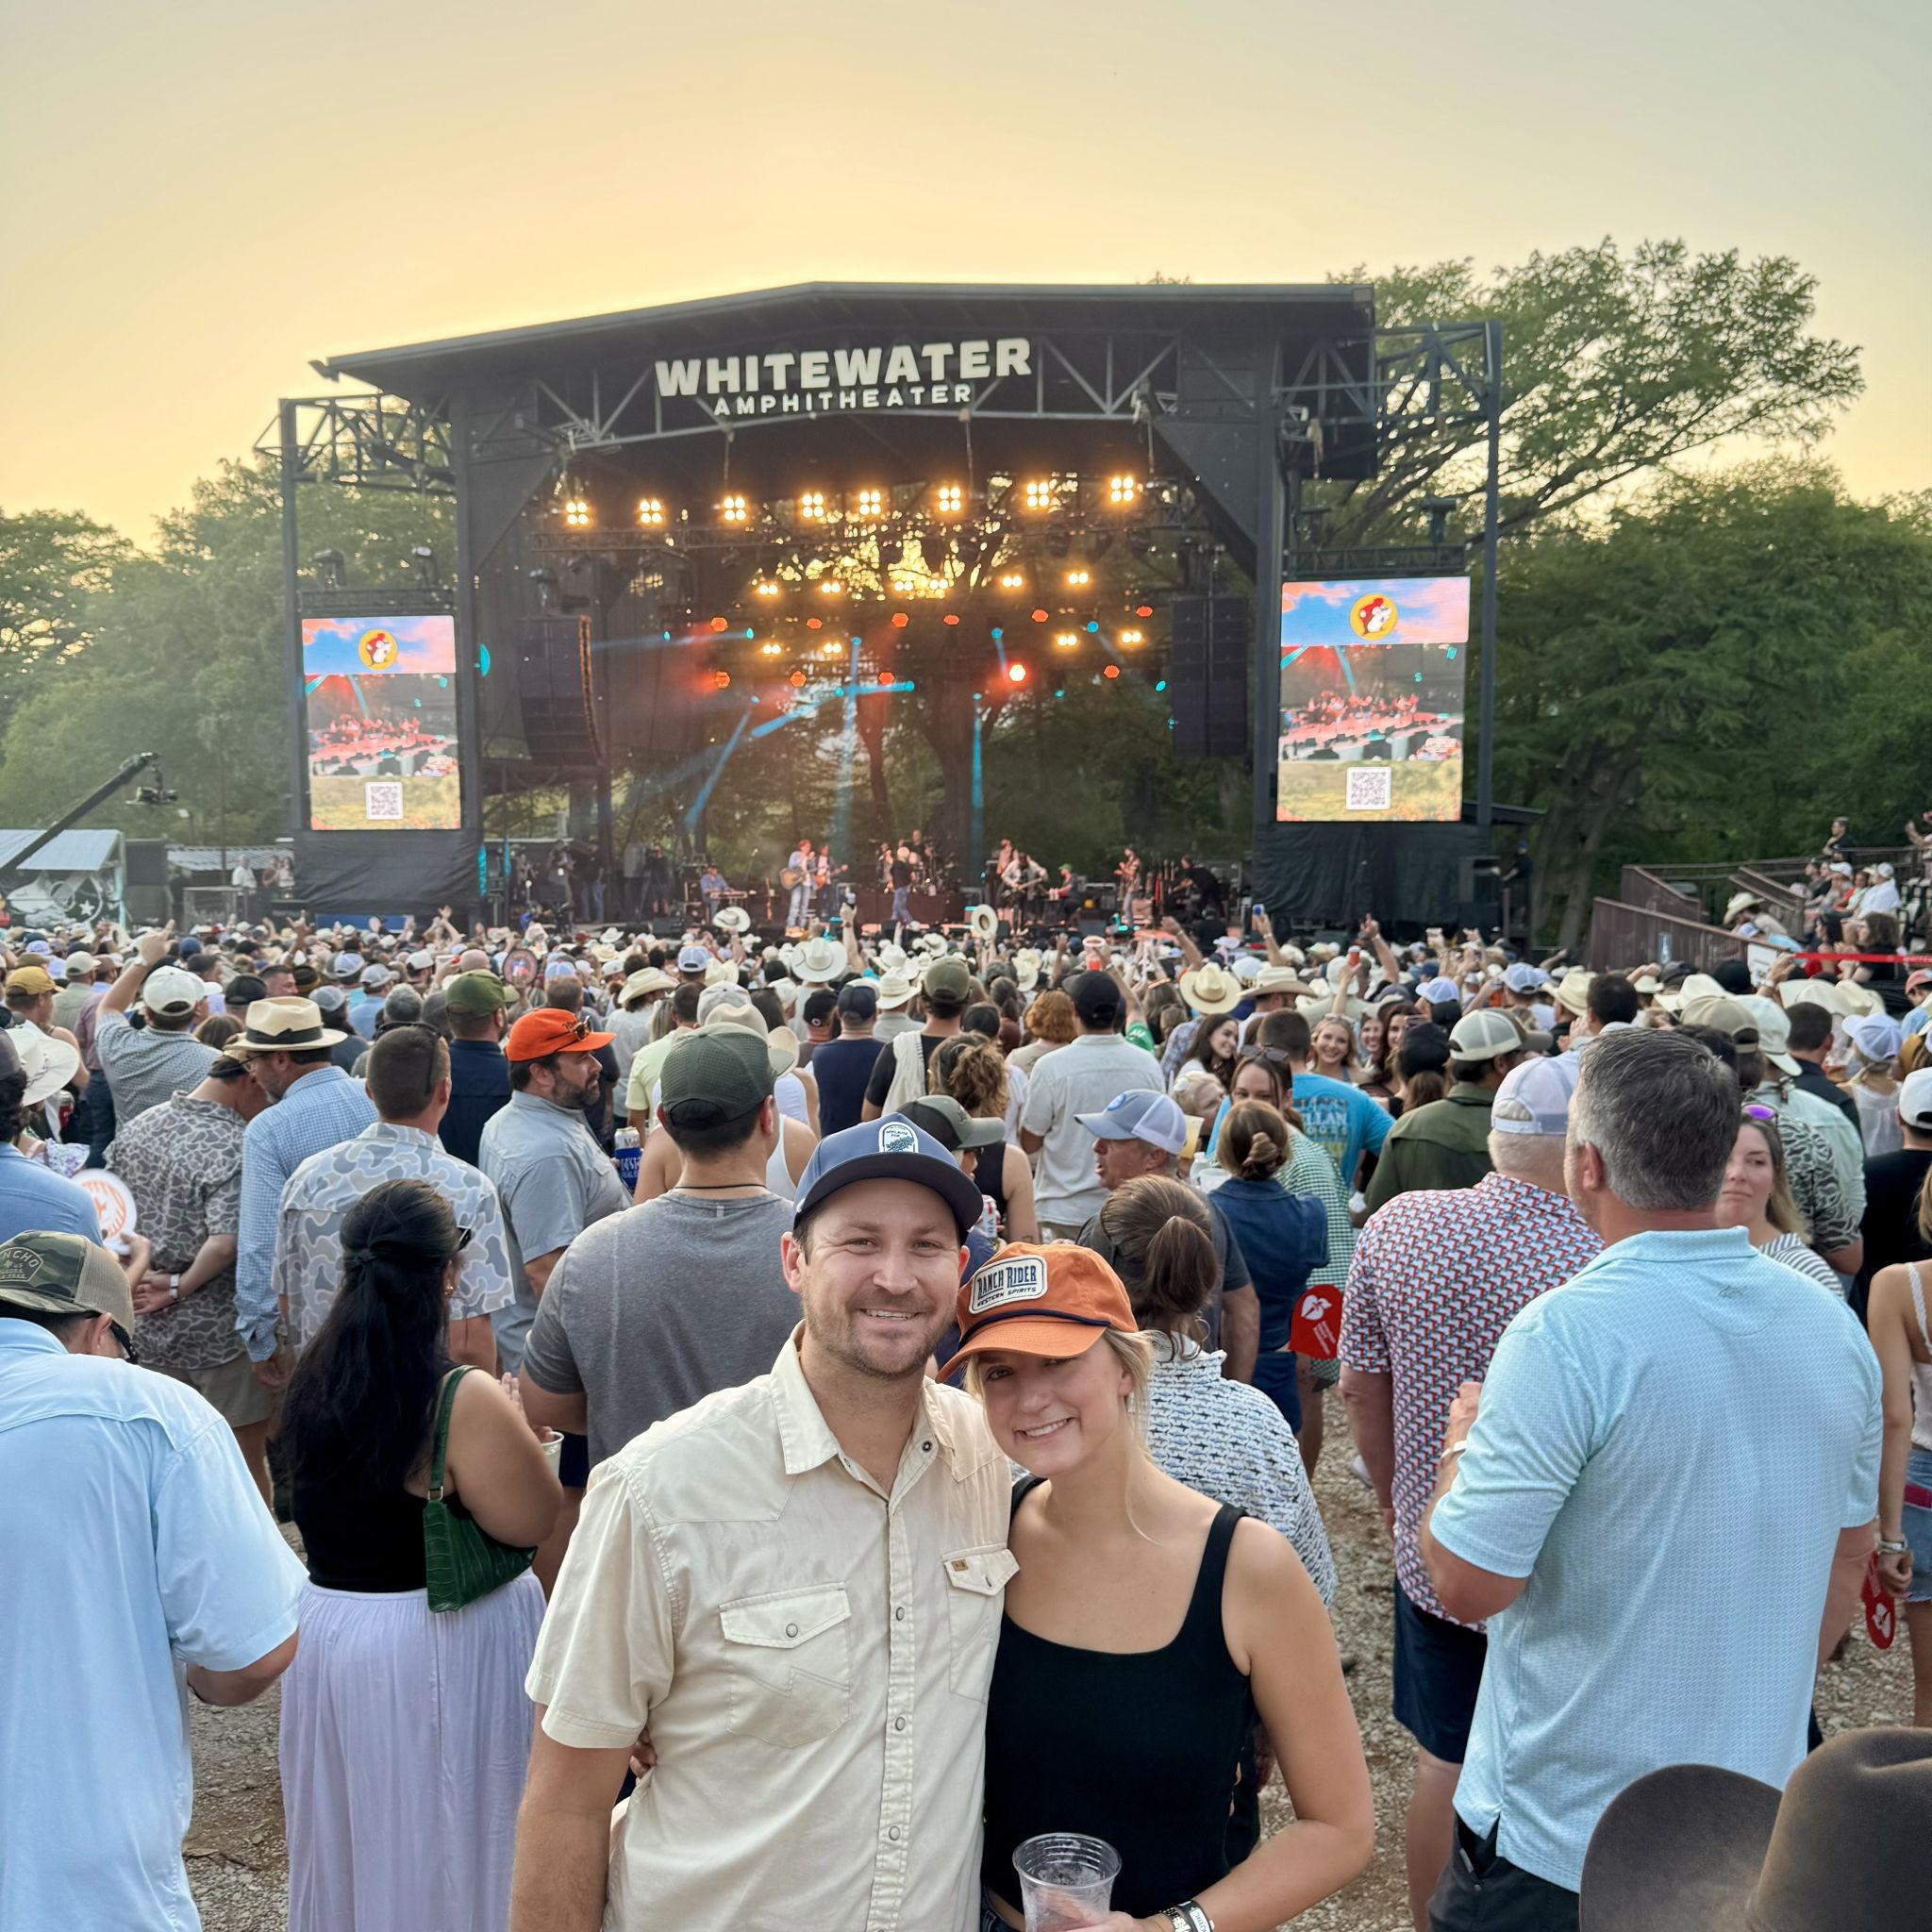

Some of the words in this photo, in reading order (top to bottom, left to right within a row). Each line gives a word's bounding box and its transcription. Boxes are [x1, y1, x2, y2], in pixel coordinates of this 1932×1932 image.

[655, 337, 1032, 397] WHITEWATER
[713, 383, 972, 416] AMPHITHEATER
[0, 1250, 40, 1268] NCHO
[977, 1269, 1004, 1300] RANCH
[1006, 1265, 1037, 1289] RIDER
[977, 1291, 1005, 1307] WESTERN
[1008, 1287, 1037, 1295] SPIRITS
